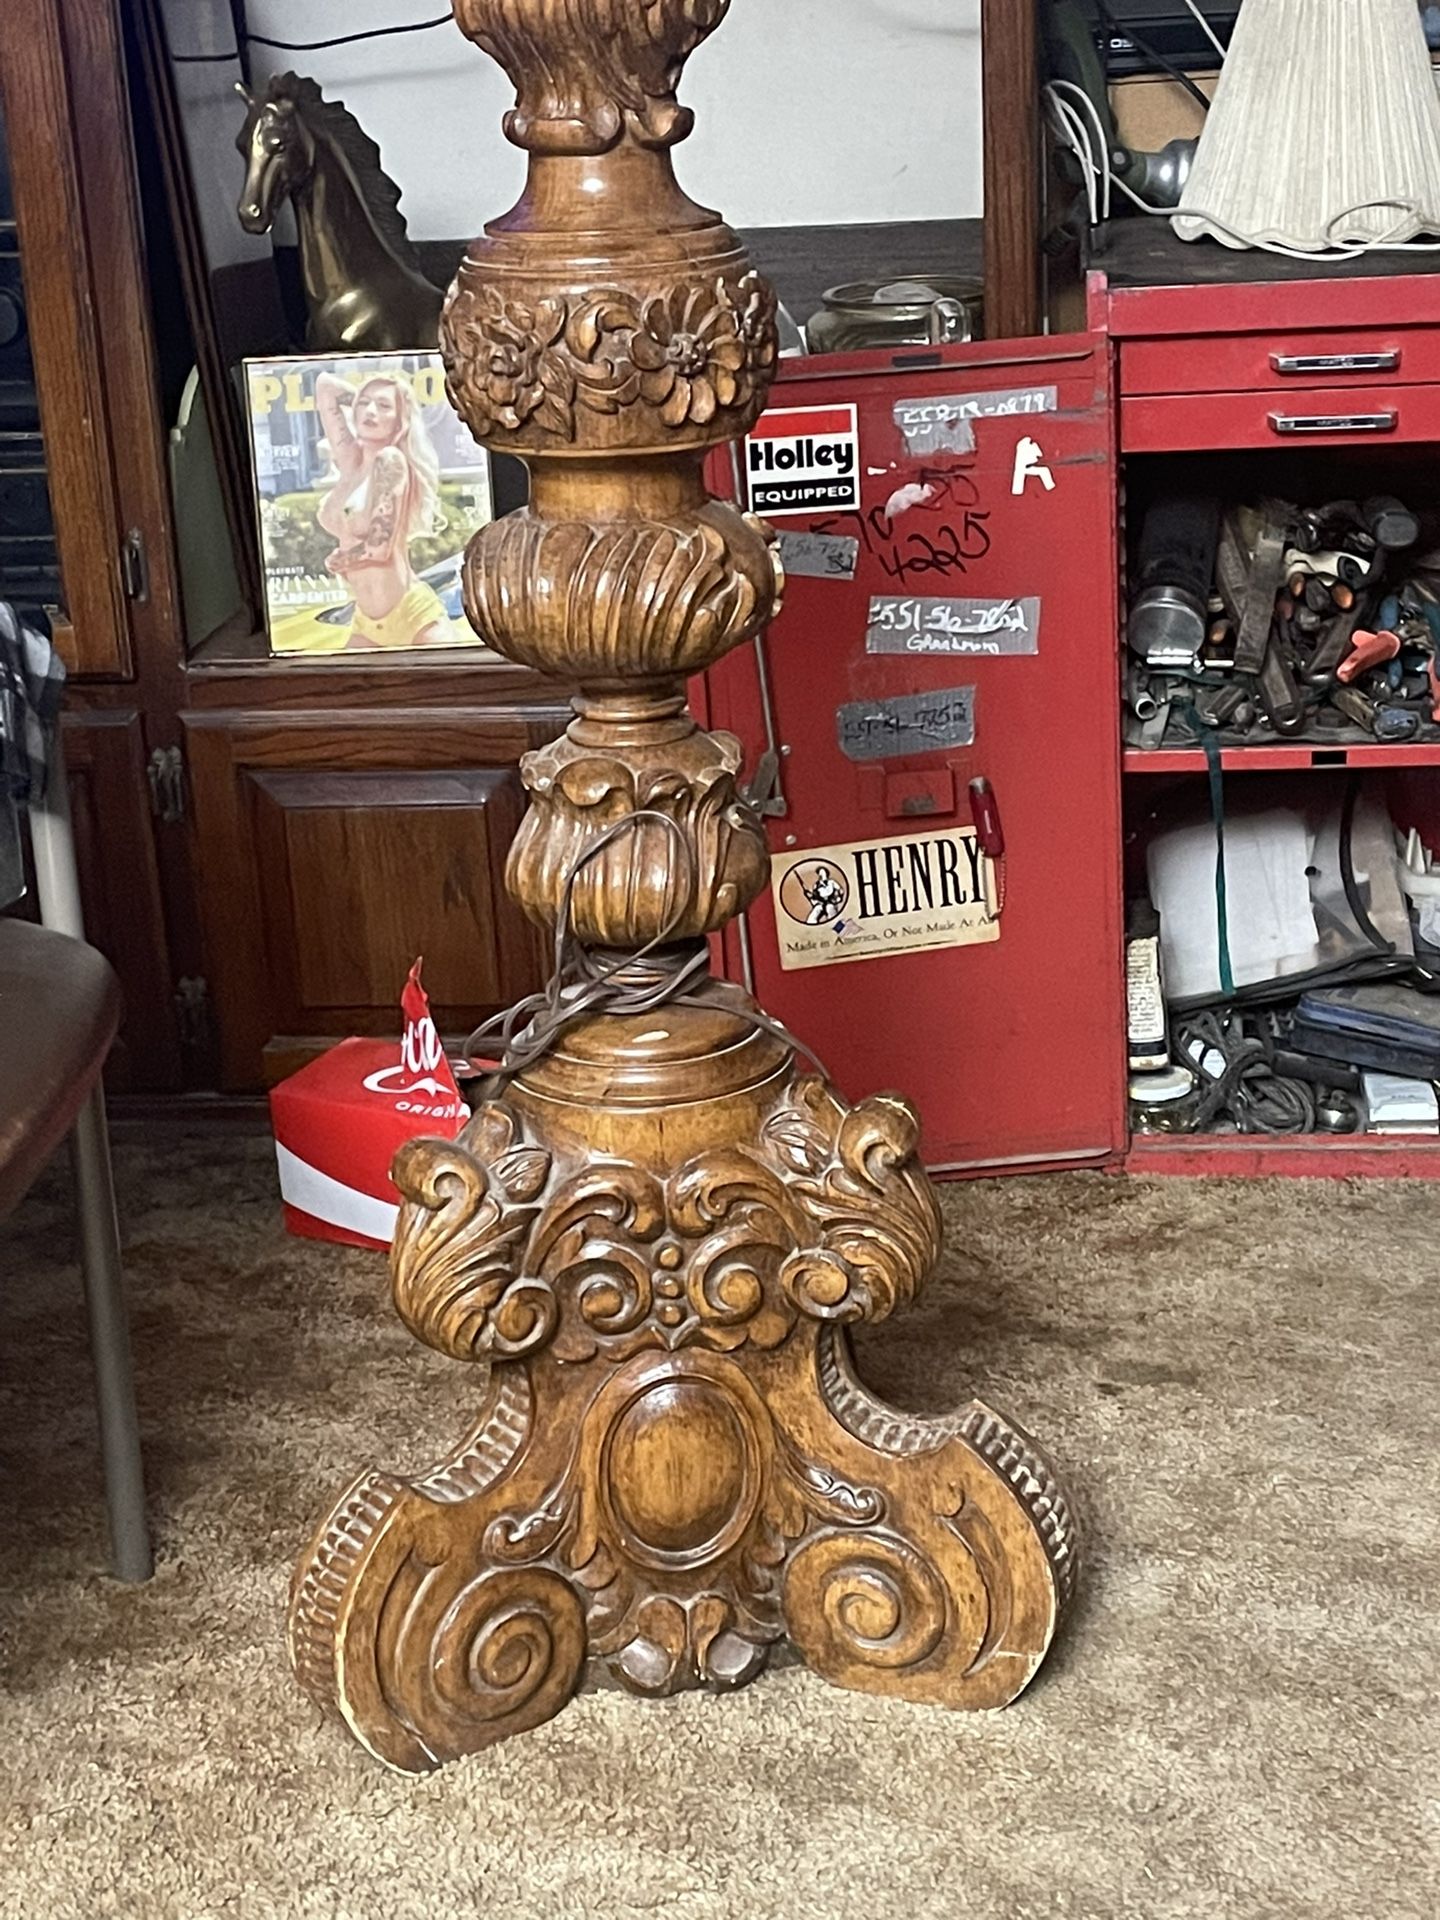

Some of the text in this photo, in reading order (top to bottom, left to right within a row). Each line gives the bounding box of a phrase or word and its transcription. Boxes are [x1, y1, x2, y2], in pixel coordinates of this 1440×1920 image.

[749, 438, 854, 475] Holley
[755, 485, 853, 503] EQUIPPED
[851, 835, 985, 919] HENRY
[786, 940, 817, 953] Made
[883, 928, 899, 939] Or
[902, 925, 923, 937] Not
[926, 919, 955, 933] Made
[960, 918, 974, 928] At
